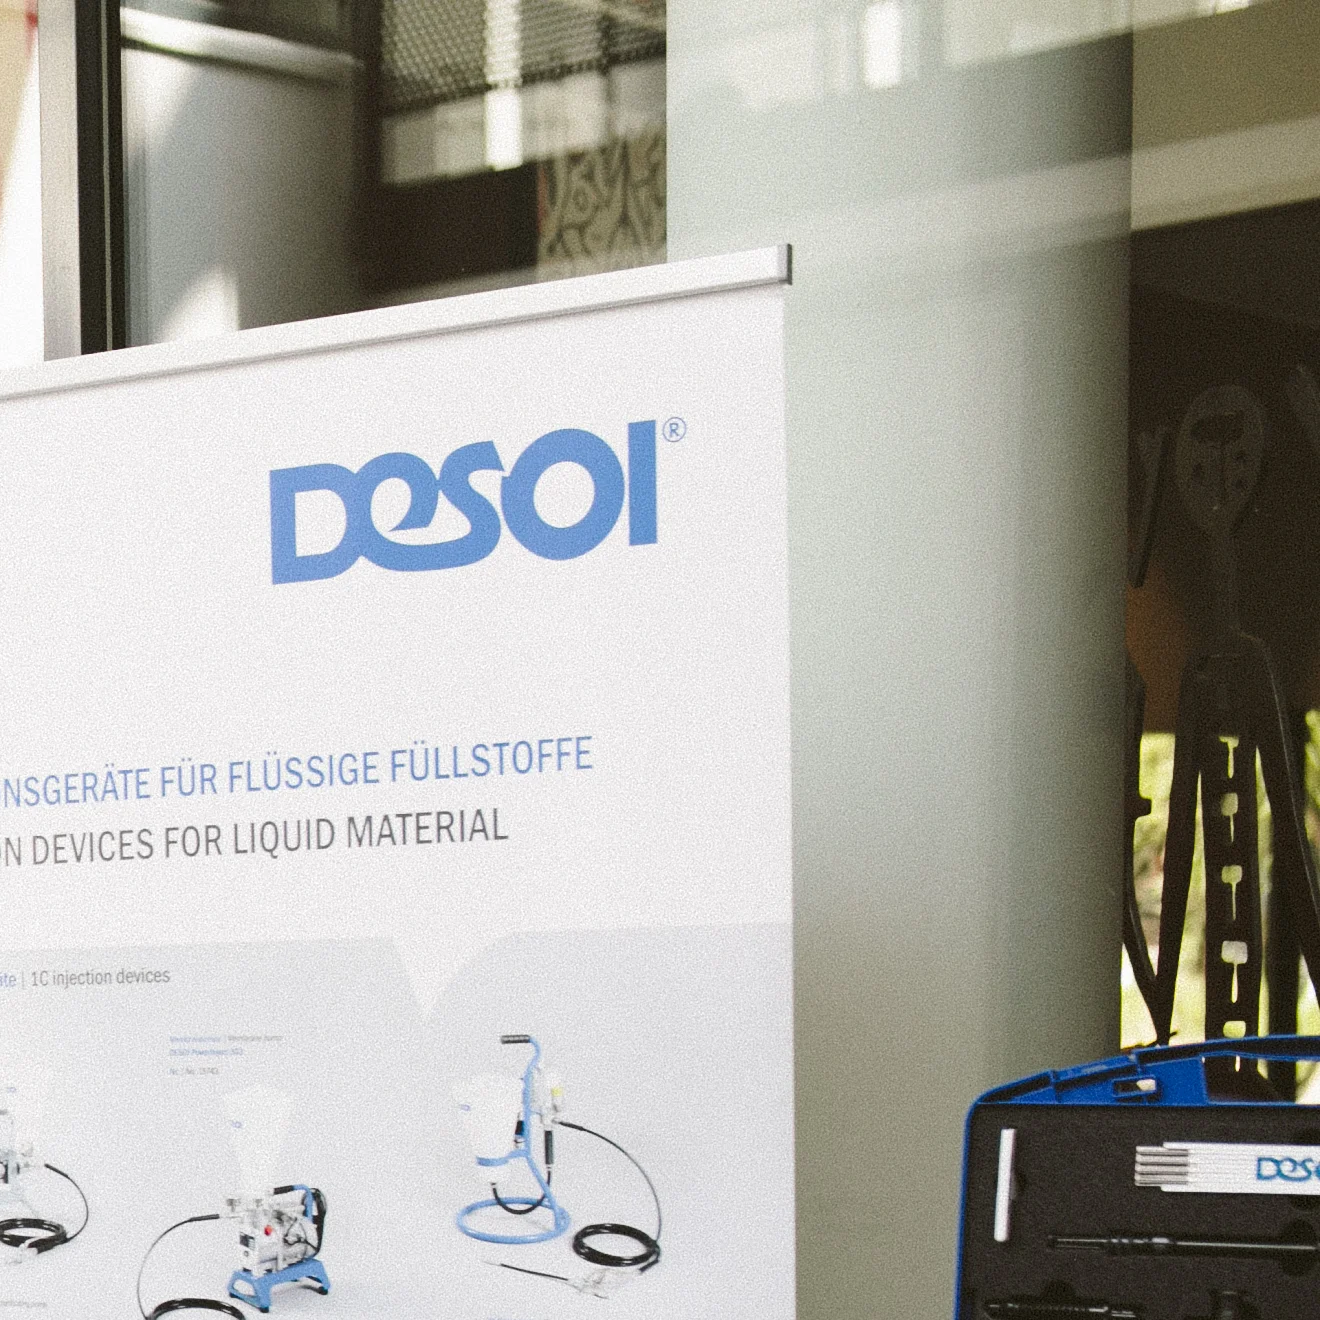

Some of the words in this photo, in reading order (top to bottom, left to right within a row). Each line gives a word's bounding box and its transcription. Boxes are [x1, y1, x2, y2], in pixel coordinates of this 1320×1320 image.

[161, 757, 217, 797] FÜR
[228, 749, 380, 794] FLÜSSIGE
[390, 736, 593, 784] FÜLLSTOFFE
[32, 828, 154, 866] DEVICES
[164, 823, 223, 858] FOR
[233, 817, 336, 860] LIQUID
[346, 806, 509, 848] MATERIAL
[31, 970, 49, 987] 1C
[52, 969, 112, 990] injection
[116, 967, 171, 986] devices
